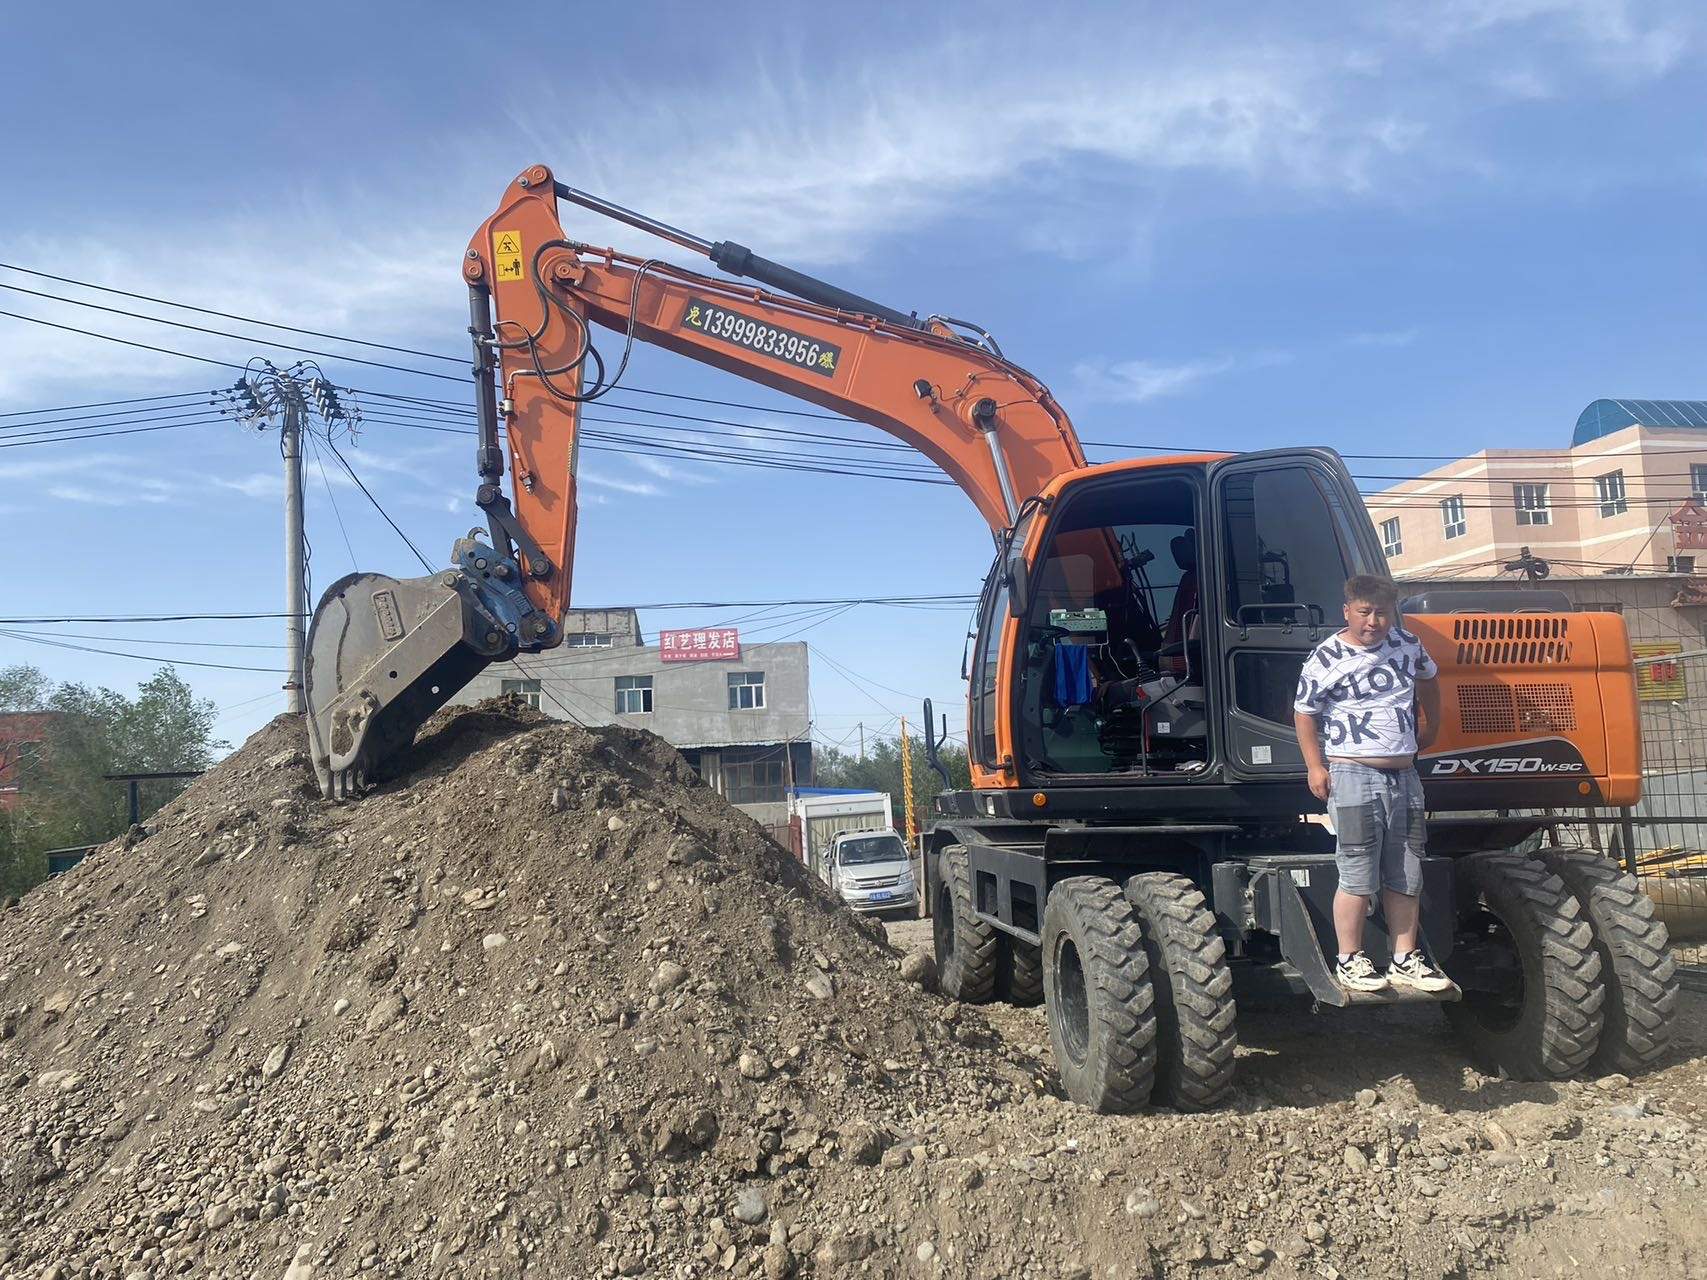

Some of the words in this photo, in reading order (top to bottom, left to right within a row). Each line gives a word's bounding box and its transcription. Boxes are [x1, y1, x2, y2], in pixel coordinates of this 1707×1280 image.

[703, 308, 819, 366] 13999833956
[664, 631, 735, 650] 红艺理发店
